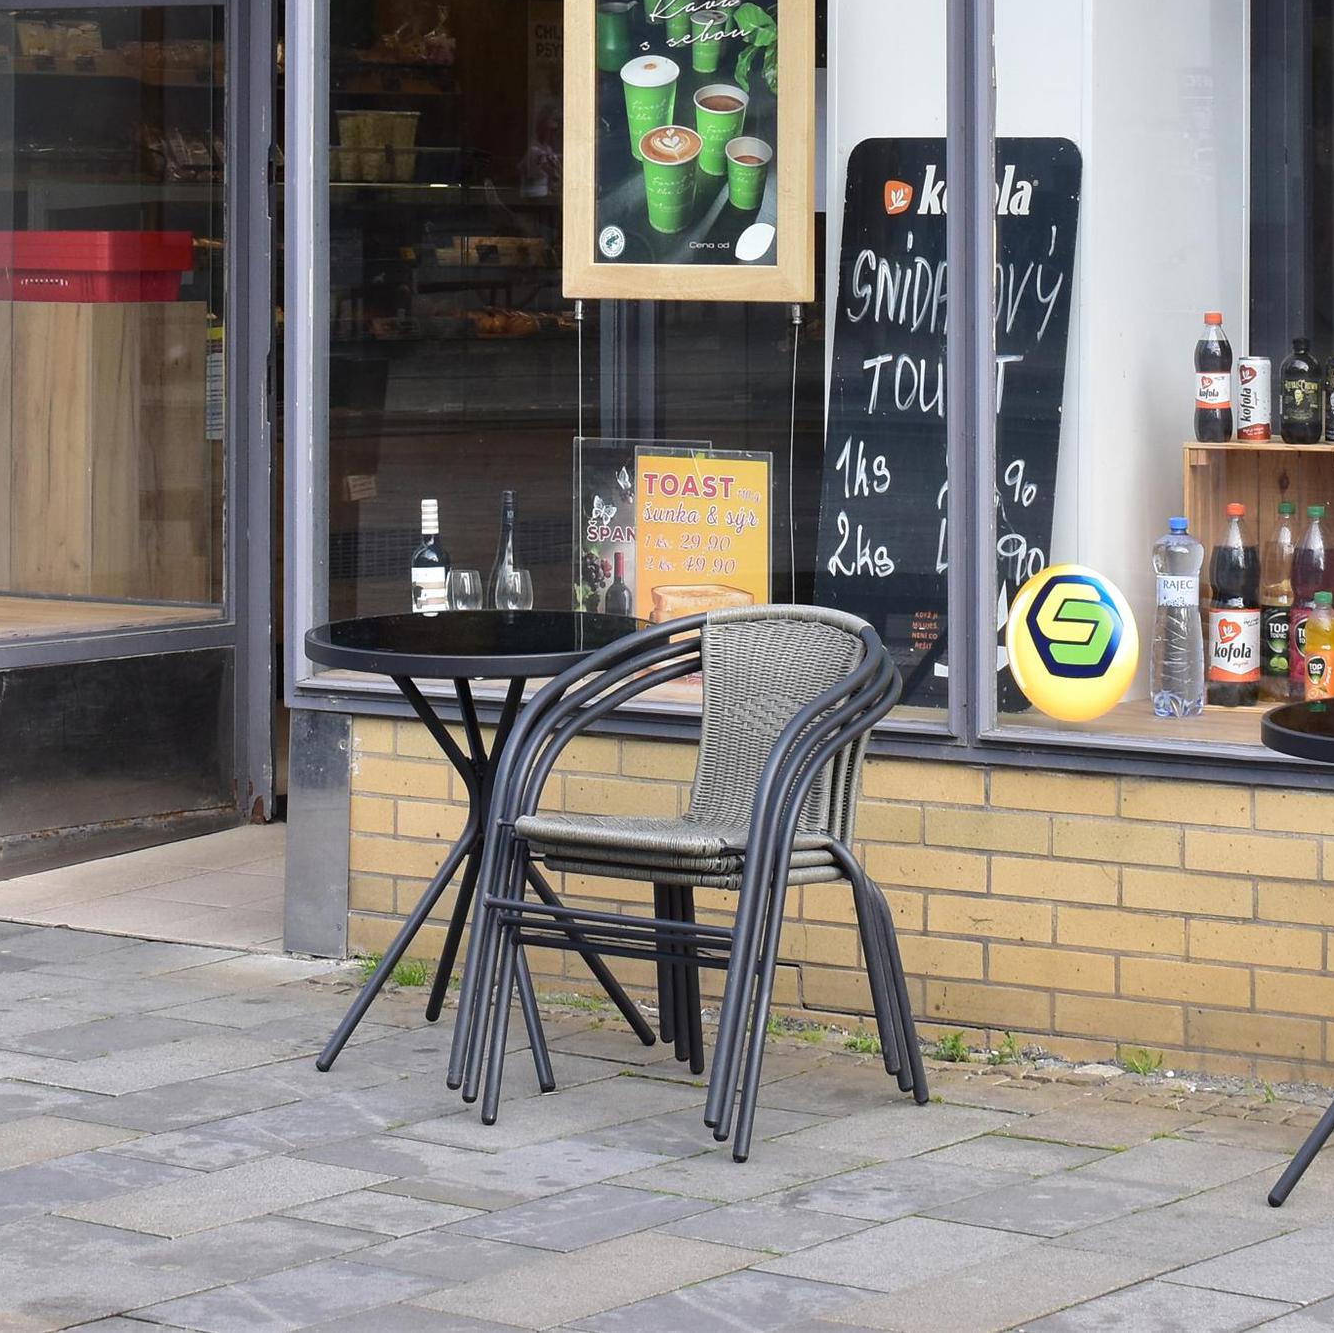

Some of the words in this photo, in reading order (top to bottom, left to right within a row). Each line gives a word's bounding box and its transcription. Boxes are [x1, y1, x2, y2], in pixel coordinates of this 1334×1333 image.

[666, 19, 751, 47] sebou
[916, 164, 1035, 216] kla
[689, 241, 715, 249] Cena
[717, 241, 730, 249] od
[847, 225, 1064, 342] SNÍDAVÝ
[862, 353, 1024, 418] TOUT
[1199, 387, 1220, 399] kofola
[1240, 387, 1253, 422] kofola
[643, 472, 736, 499] TOAST
[643, 501, 700, 525] šunka
[706, 505, 718, 525] &
[725, 507, 759, 535] sýr
[1163, 579, 1194, 591] RAJEC
[1269, 622, 1289, 633] TOP
[1213, 642, 1252, 663] kofola
